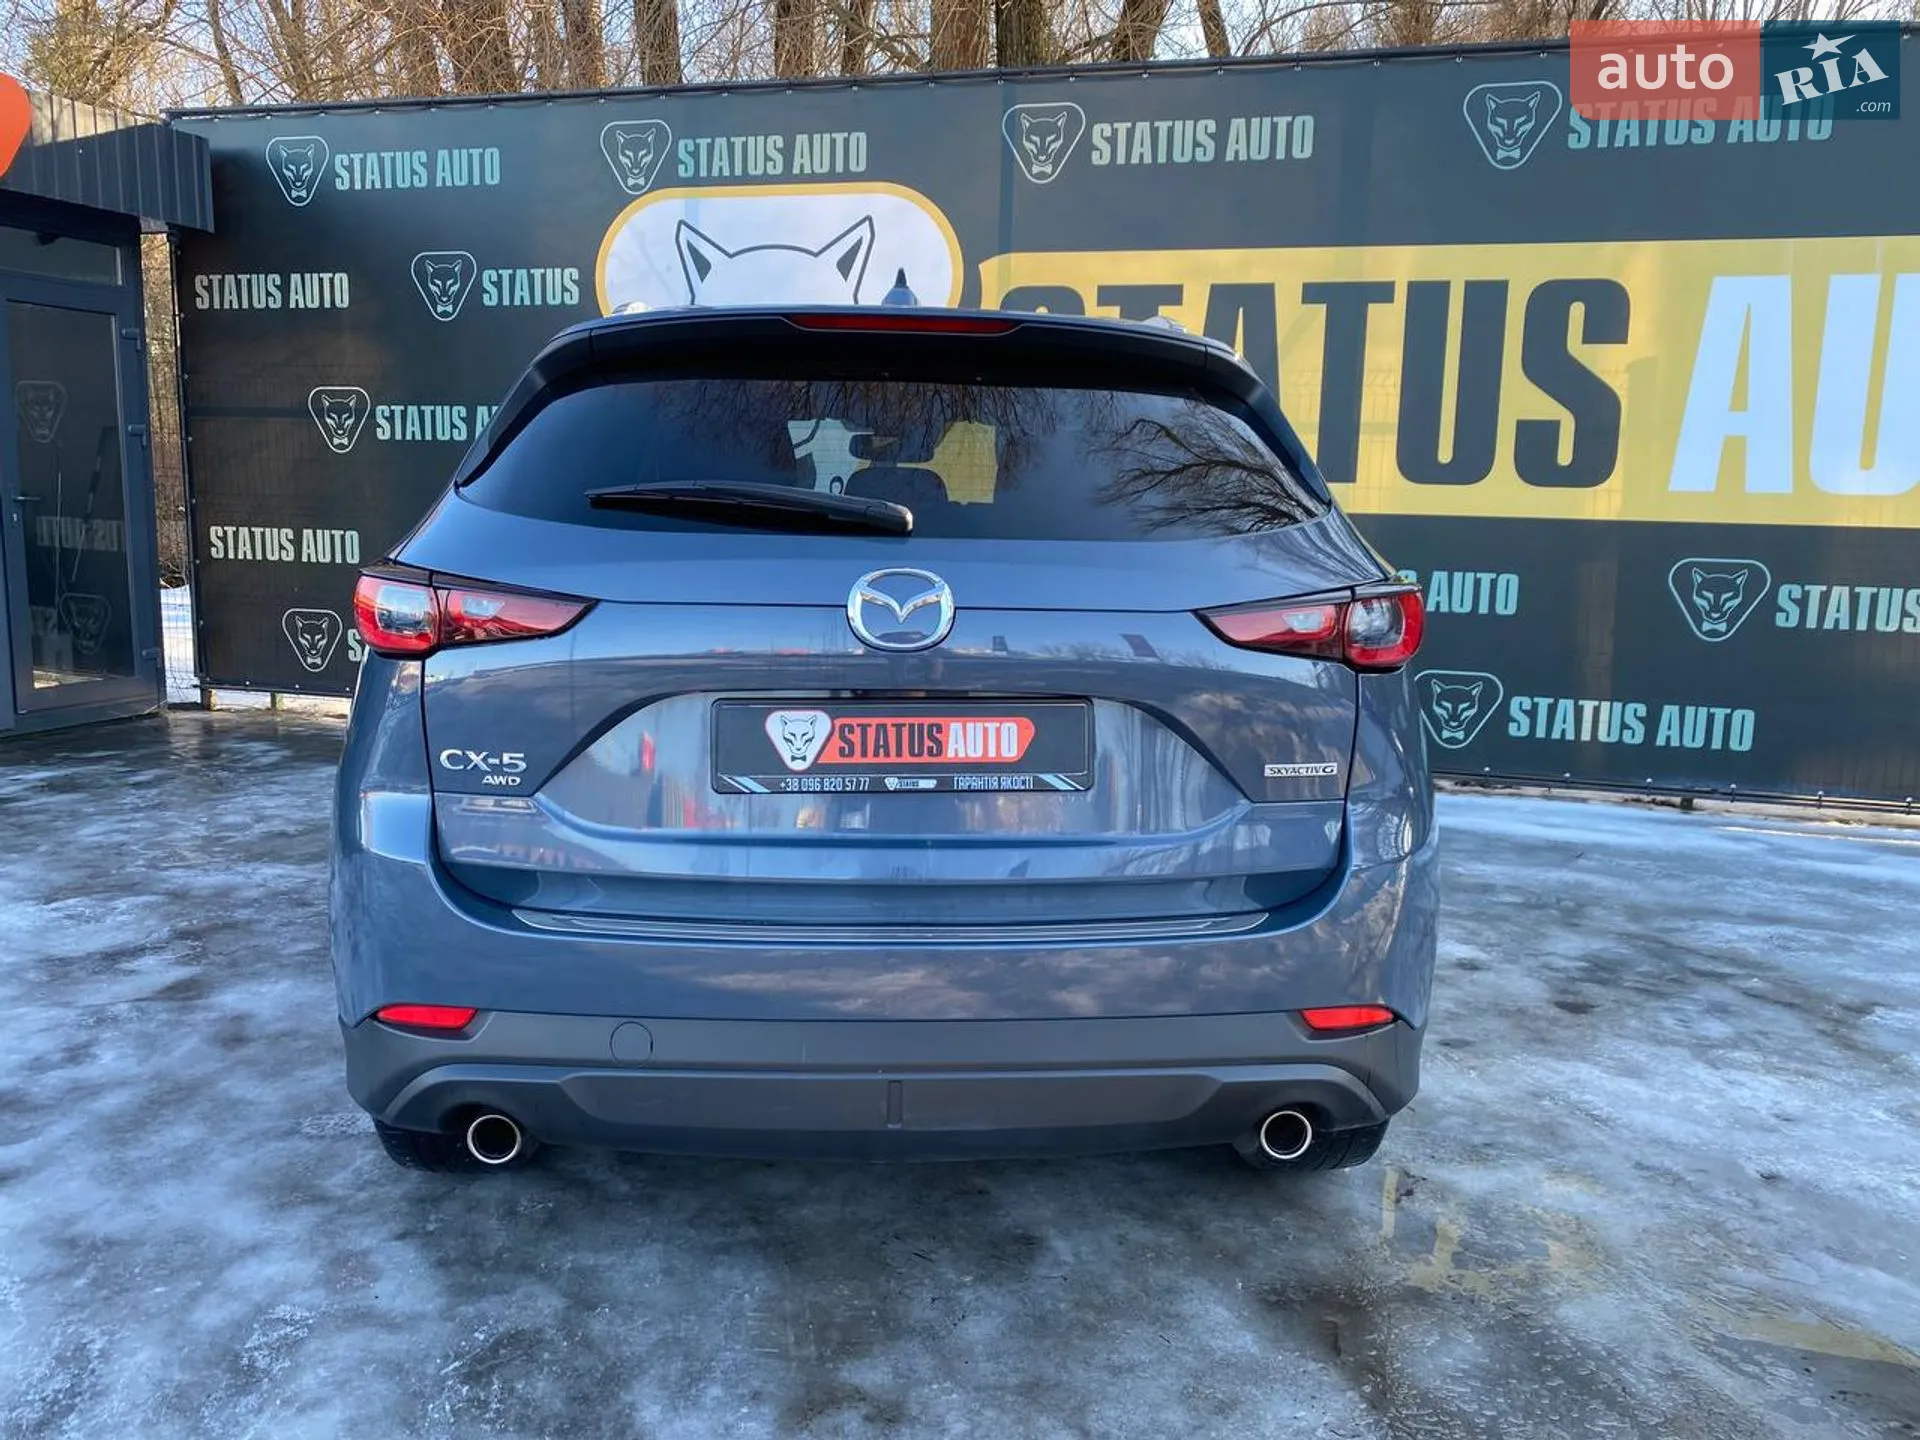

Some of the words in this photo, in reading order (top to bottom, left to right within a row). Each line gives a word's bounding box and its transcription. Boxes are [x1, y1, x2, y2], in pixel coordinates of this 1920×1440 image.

[677, 135, 784, 178] STATUS
[793, 131, 868, 175] AUTO
[1091, 119, 1215, 166] STATUS
[1225, 115, 1315, 162] AUTO
[334, 150, 428, 191] STATUS
[436, 147, 500, 187] AUTO
[195, 274, 282, 310] STATUS
[289, 273, 349, 309] AUTO
[482, 267, 579, 306] STATUS
[375, 404, 468, 441] STATUS
[210, 526, 294, 562] STATUS
[301, 528, 360, 564] AUTO
[1426, 570, 1519, 615] AUTO
[1775, 583, 1920, 633] STATUS
[1508, 696, 1646, 745] STATUS
[1656, 704, 1755, 752] AUTO
[440, 748, 527, 773] CX-5
[482, 775, 521, 786] AWD
[780, 777, 800, 791] +38
[801, 777, 821, 791] 096
[823, 777, 843, 791] 820
